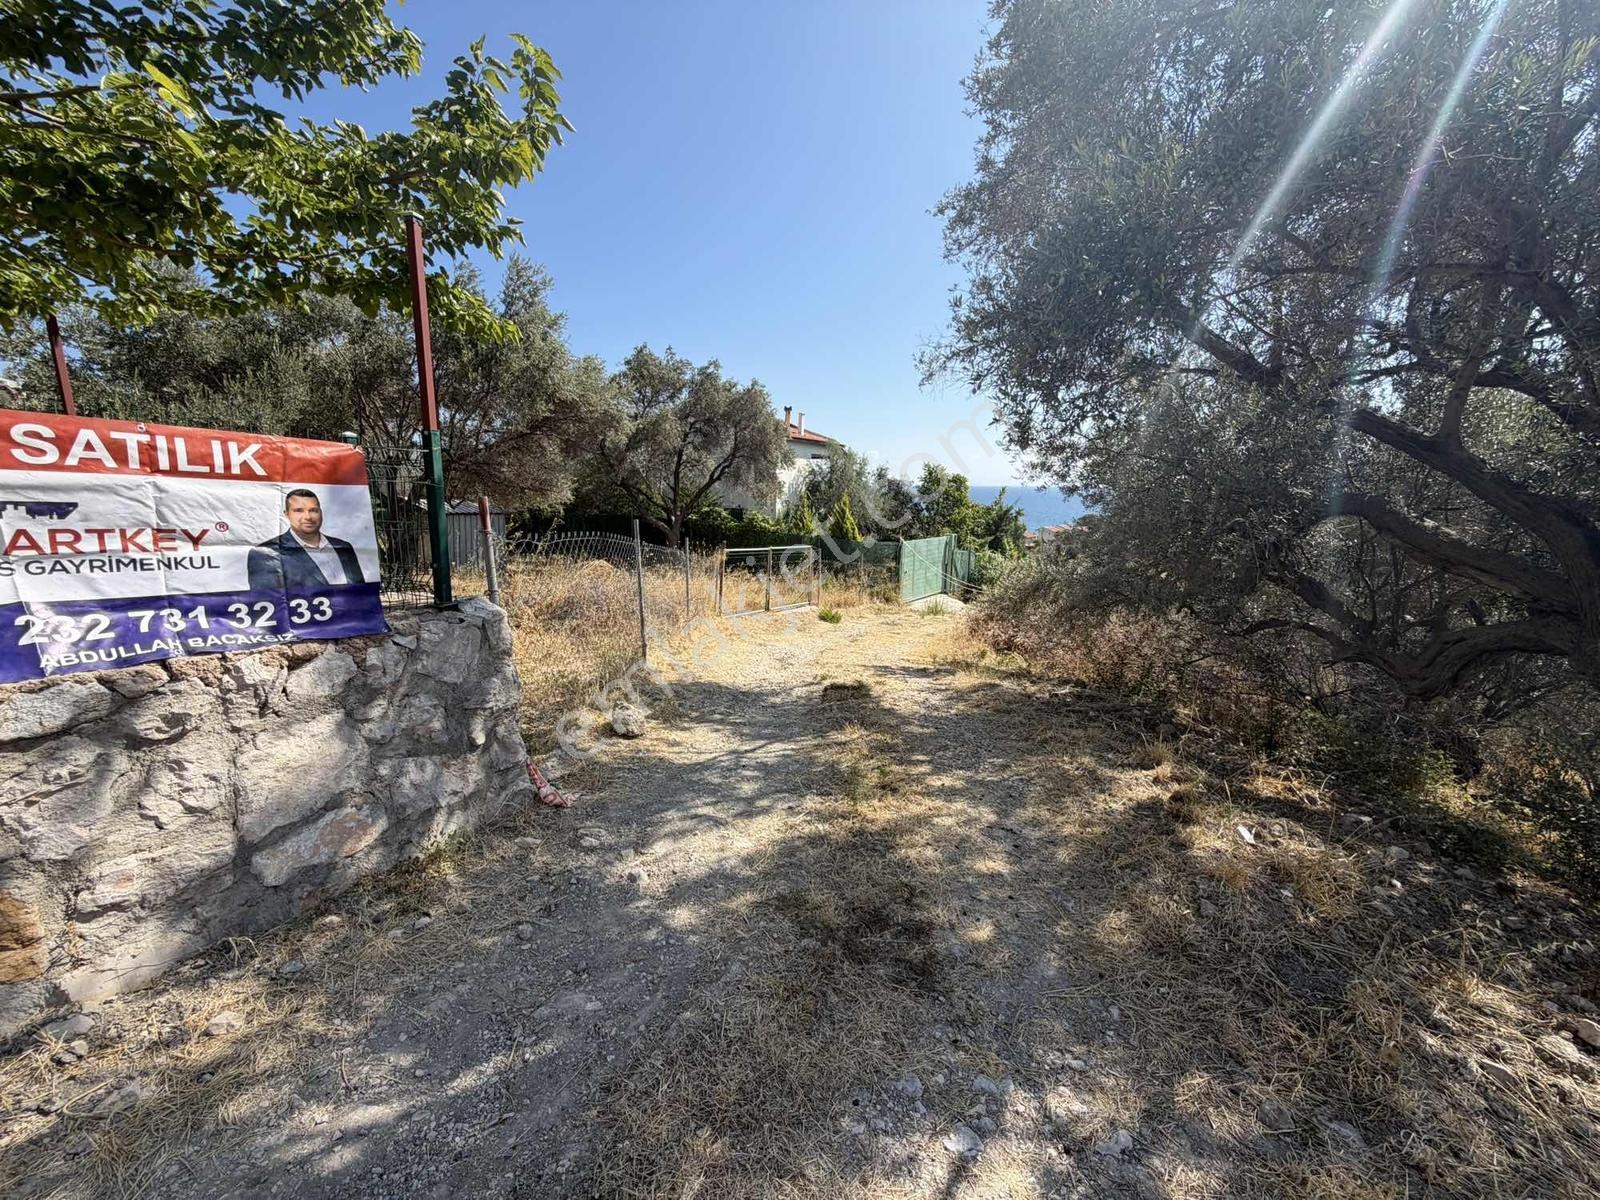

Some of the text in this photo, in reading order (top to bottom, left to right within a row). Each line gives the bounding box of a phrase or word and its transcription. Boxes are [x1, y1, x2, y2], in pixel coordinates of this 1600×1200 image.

[9, 423, 268, 476] SATILIK
[24, 555, 220, 575] GAYRİMENKUL
[14, 597, 333, 645] 232 731 32 33
[40, 638, 183, 668] ABDULLAH
